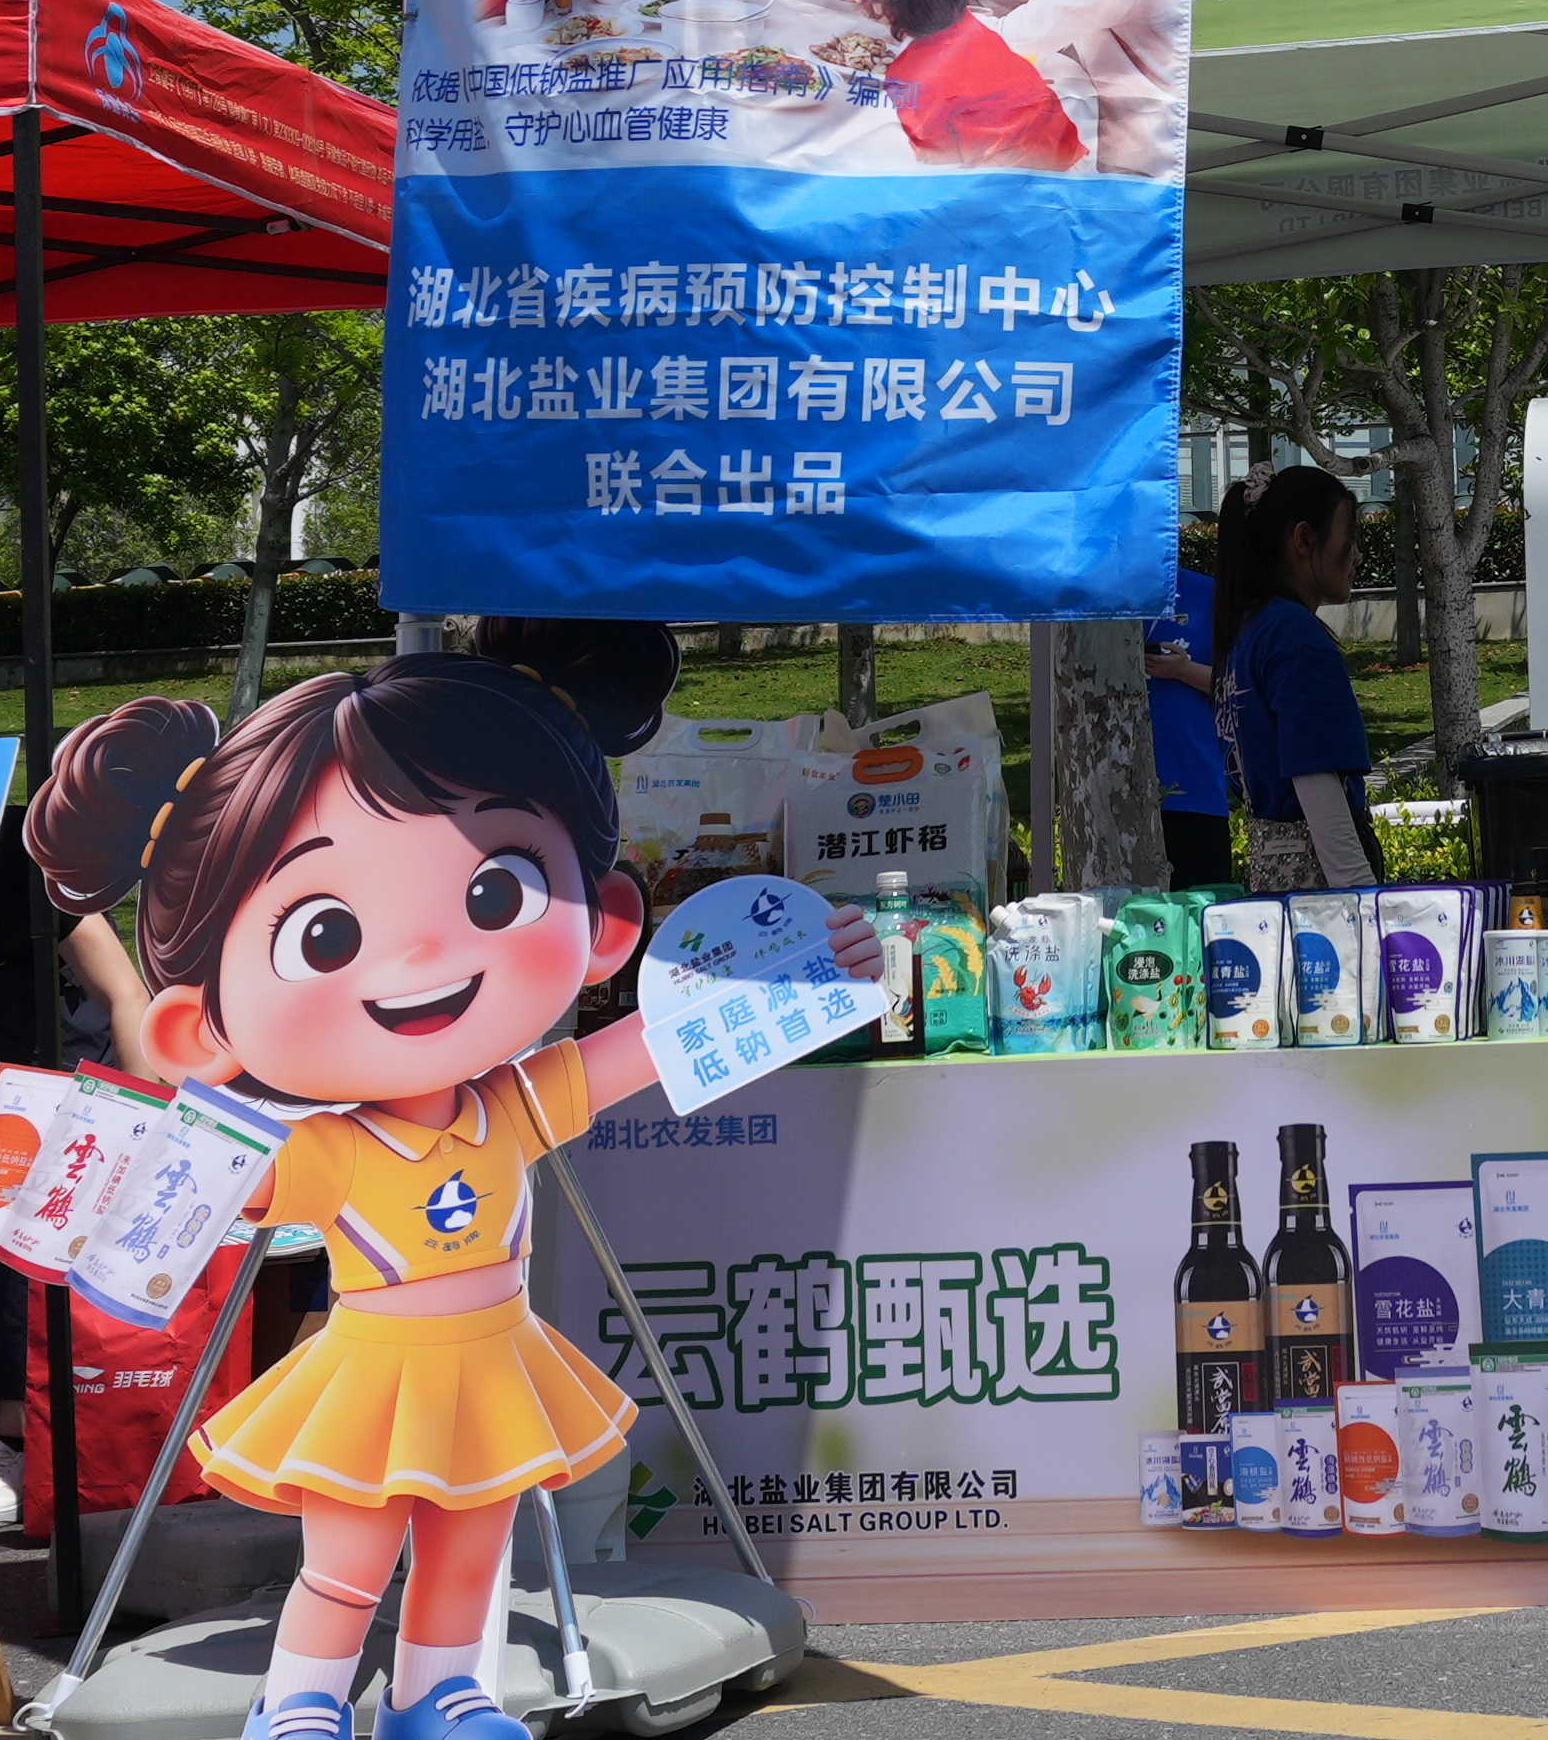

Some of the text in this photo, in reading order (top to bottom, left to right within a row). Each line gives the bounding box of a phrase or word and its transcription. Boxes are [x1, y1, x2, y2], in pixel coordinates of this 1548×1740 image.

[504, 106, 731, 149] 守护心血管健康
[406, 260, 1113, 334] 湖北省疾病预防控制中心
[421, 354, 1075, 426] 湖北盐业集团有限公司
[586, 449, 846, 517] 联合出品
[877, 792, 921, 808] 楚小田
[817, 823, 949, 861] 潜江虾稻
[668, 940, 734, 980] 湖北盐业集团
[1004, 944, 1061, 962] 洗涤盐
[676, 954, 842, 1054] 家庭减盐
[692, 987, 857, 1088] 低钠首选
[587, 1114, 779, 1151] 湖北农发集团
[599, 1243, 1119, 1412] 云鹤甄选
[1374, 1297, 1436, 1320] 雪花盐
[789, 1508, 1009, 1534] SALT GROUP LTD.
